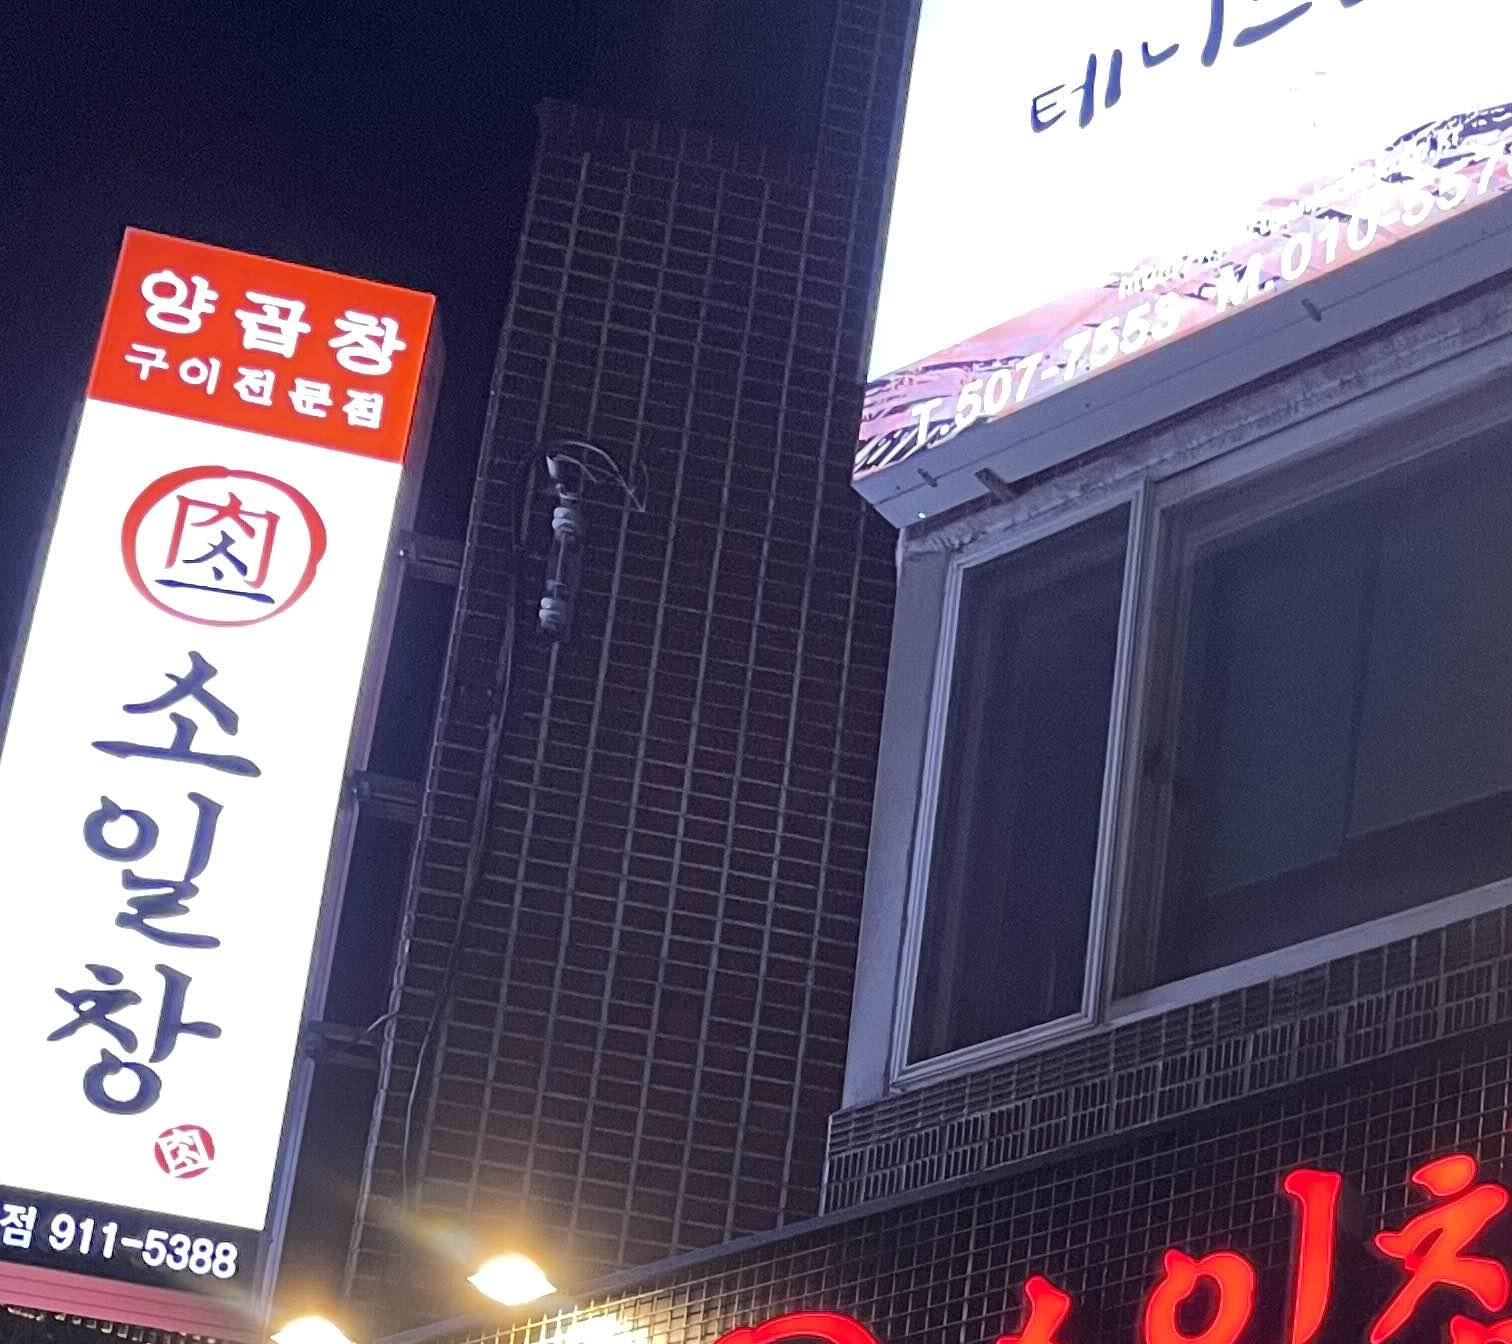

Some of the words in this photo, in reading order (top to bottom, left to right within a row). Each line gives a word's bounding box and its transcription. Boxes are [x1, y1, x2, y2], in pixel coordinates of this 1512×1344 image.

[140, 268, 407, 376] 양곱창
[124, 343, 385, 430] 구이전문점
[47, 650, 262, 1115] 소일창
[49, 1212, 239, 1279] 911-5388
